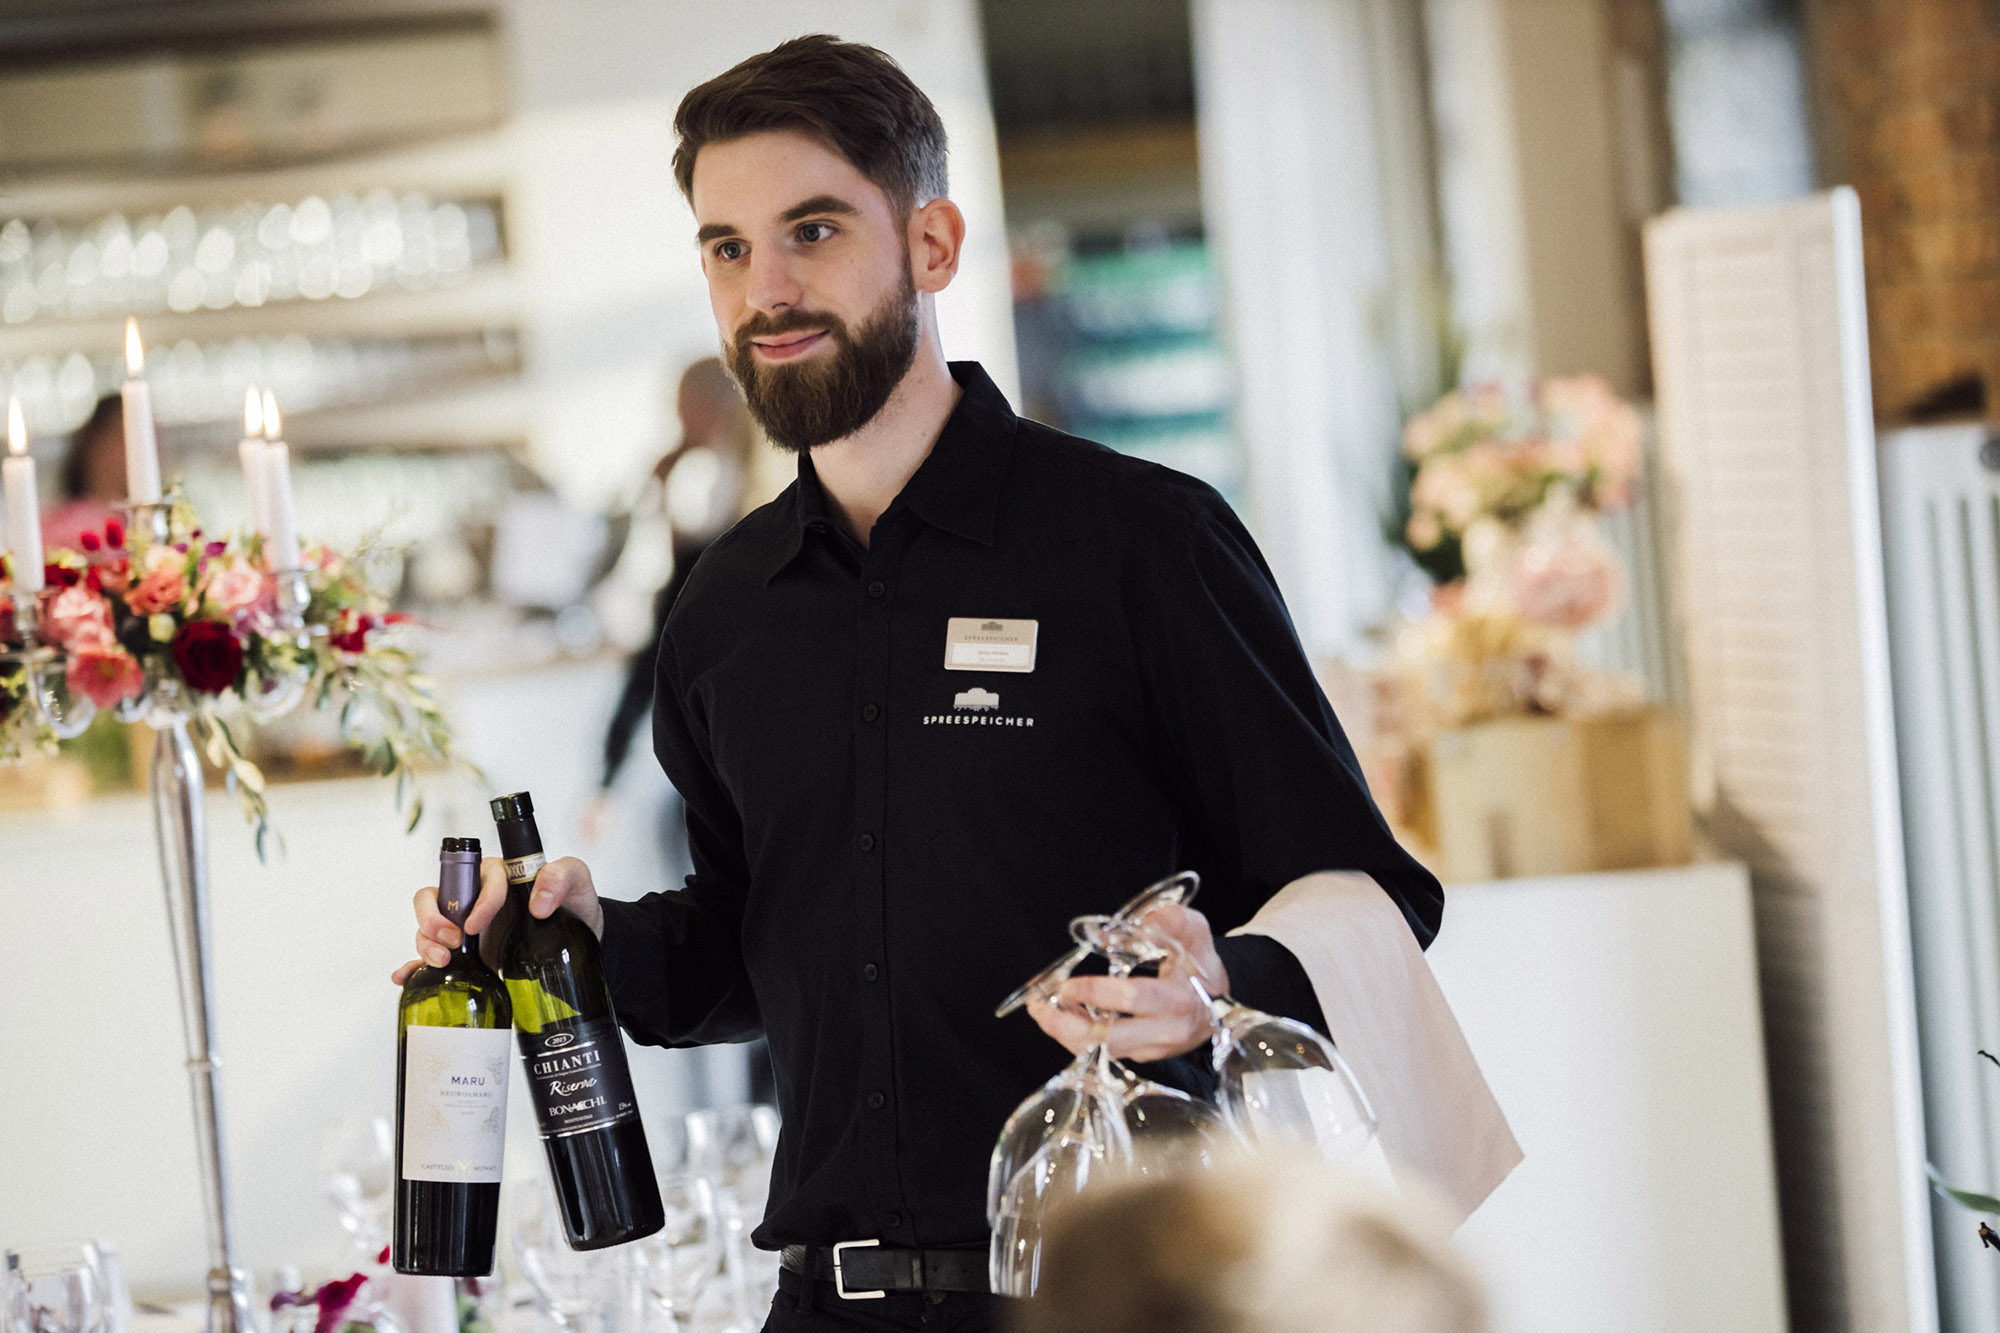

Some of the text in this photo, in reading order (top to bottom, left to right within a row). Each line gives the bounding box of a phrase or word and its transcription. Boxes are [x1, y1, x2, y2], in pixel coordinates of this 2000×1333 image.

[923, 715, 1034, 726] SPREESPEICHER
[552, 1035, 567, 1045] 2015
[533, 1050, 601, 1075] CHIANTI
[451, 1076, 486, 1086] MARU
